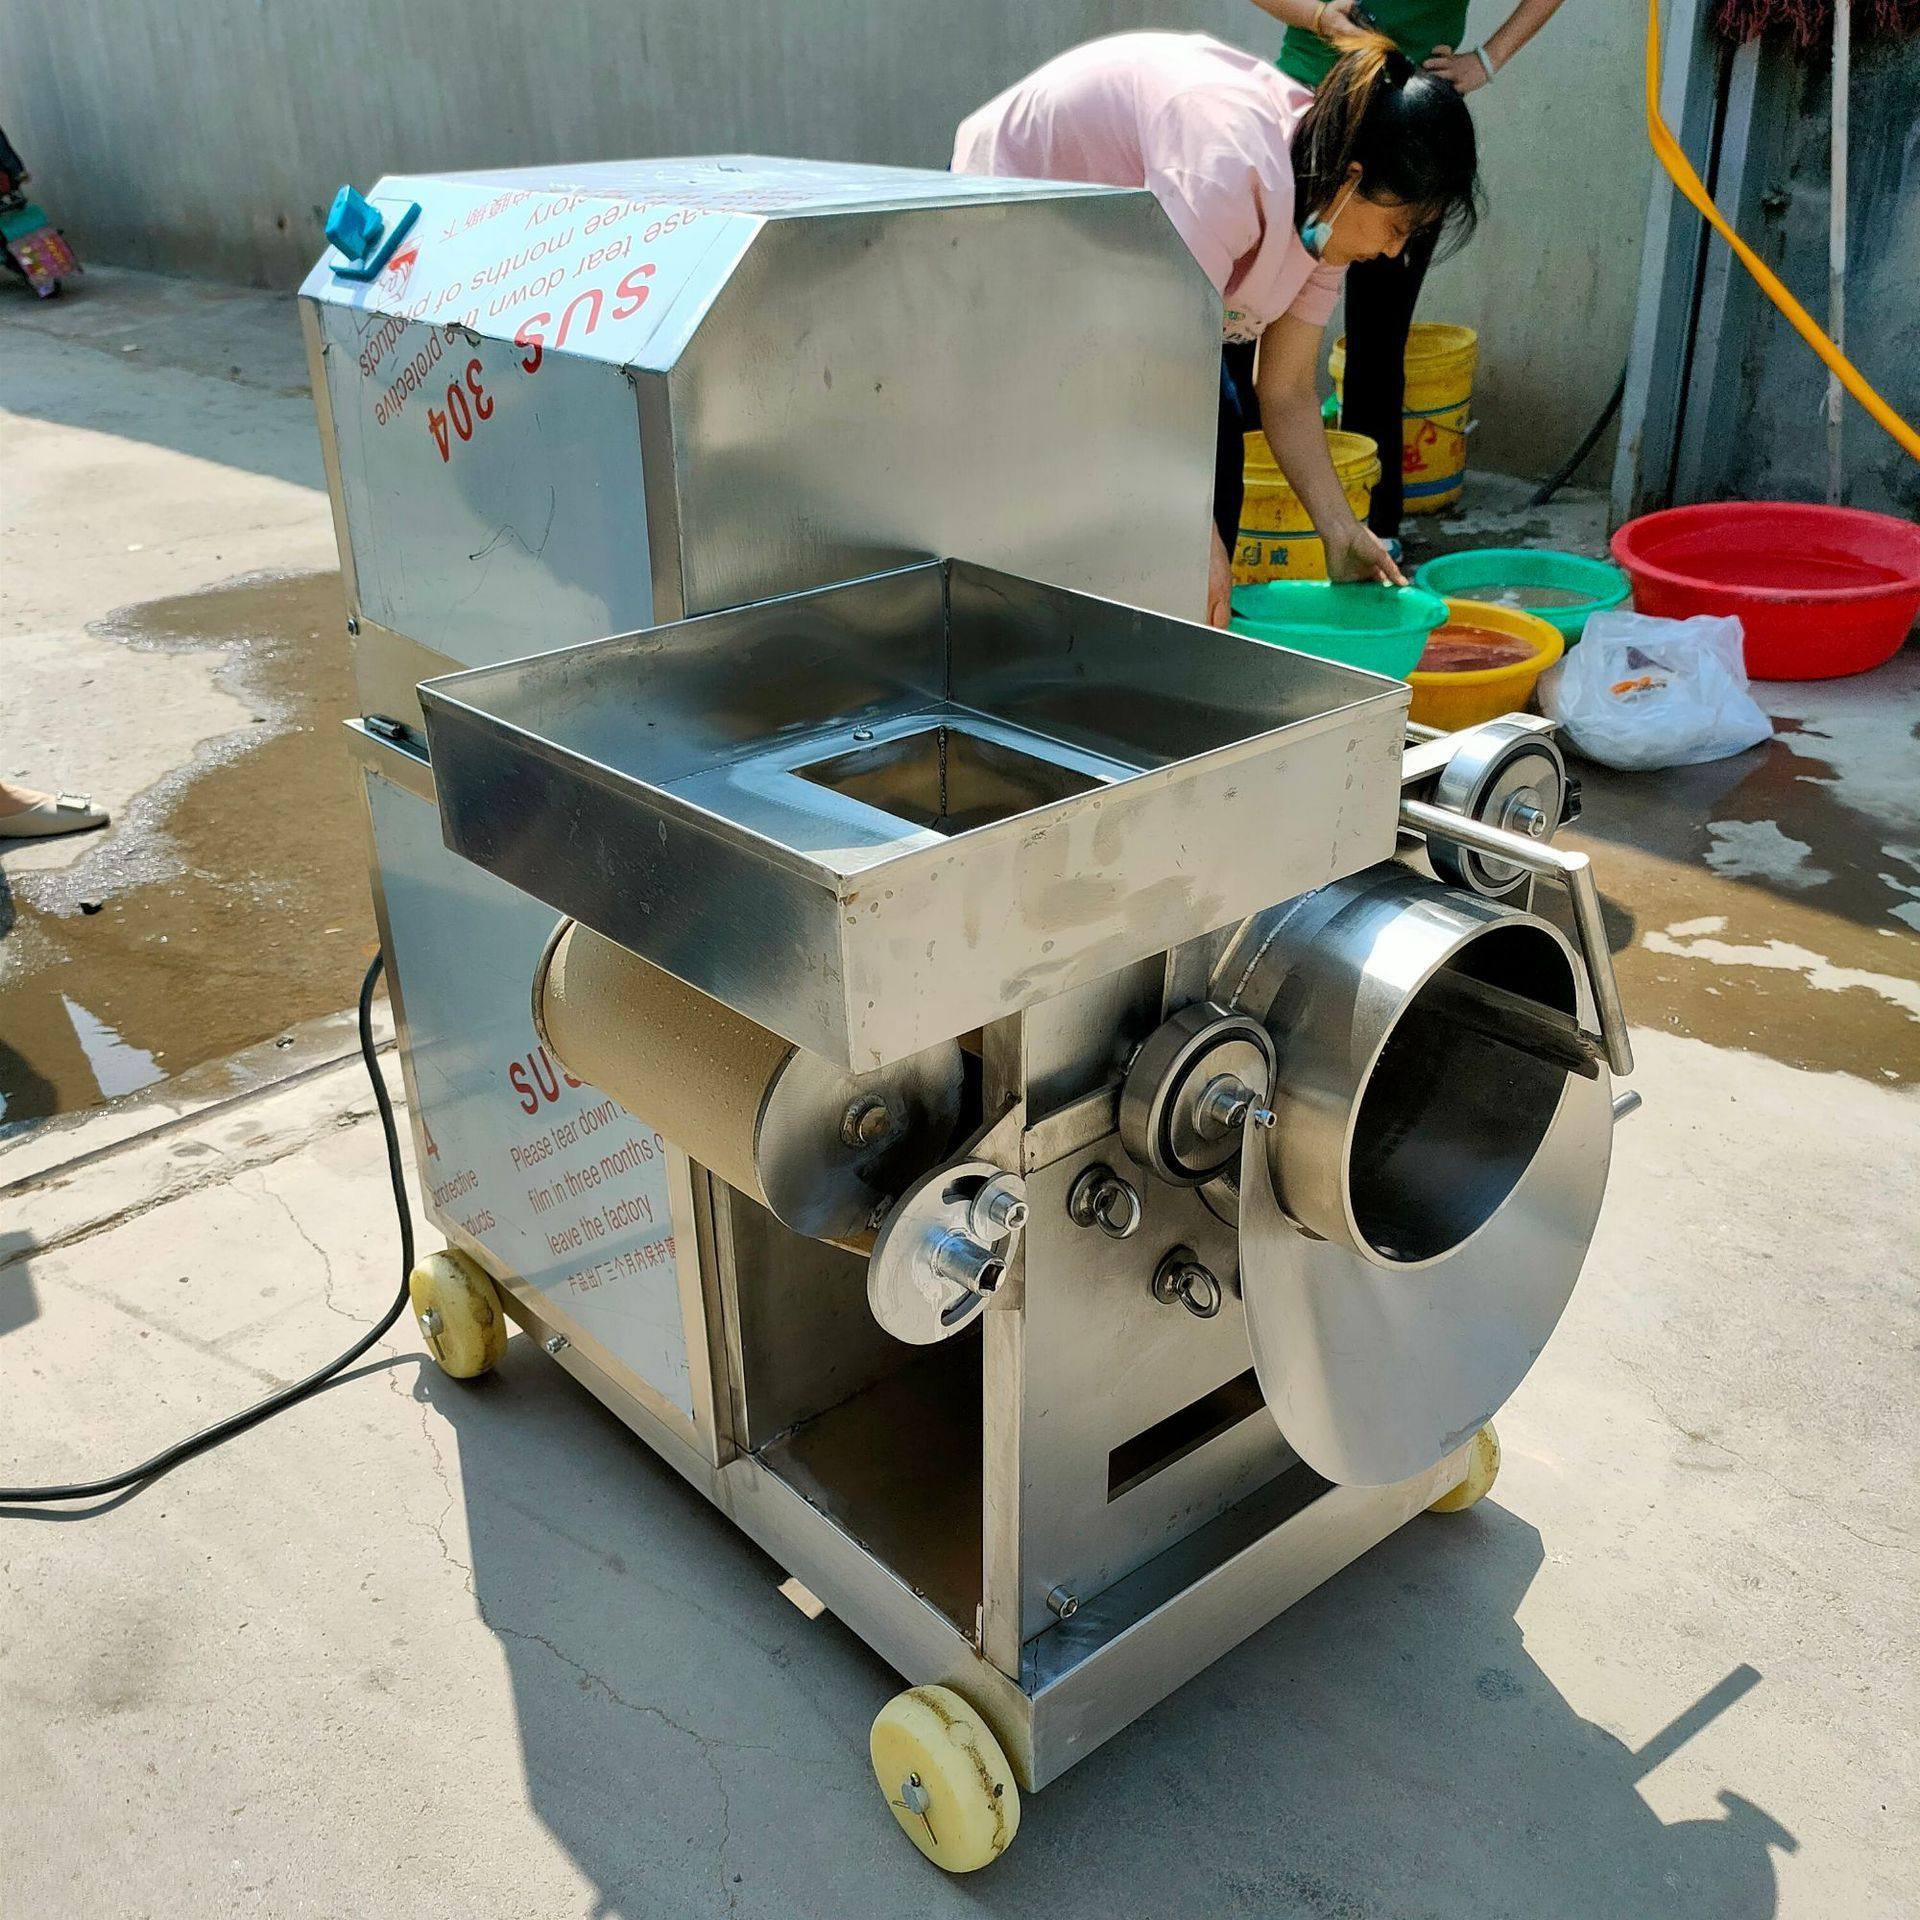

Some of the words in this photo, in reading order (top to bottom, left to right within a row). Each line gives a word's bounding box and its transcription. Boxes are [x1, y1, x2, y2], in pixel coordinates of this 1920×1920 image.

[523, 195, 590, 231] tory
[584, 200, 650, 236] hree
[643, 208, 711, 244] ase
[471, 224, 575, 293] months
[488, 266, 566, 320] down
[572, 238, 632, 282] tear
[433, 279, 463, 311] of
[514, 262, 657, 375] SUS
[357, 289, 433, 379] products
[373, 328, 444, 428] protective
[428, 358, 495, 464] 304
[509, 1046, 583, 1115] SU
[510, 1135, 554, 1172] Please
[550, 1122, 579, 1151] tear
[578, 1100, 619, 1135] down
[528, 1187, 555, 1214] film
[550, 1179, 568, 1204] in
[563, 1165, 602, 1197] three
[600, 1138, 654, 1180] months
[544, 1226, 583, 1256] leave
[579, 1215, 606, 1242] the
[601, 1194, 654, 1232] factory
